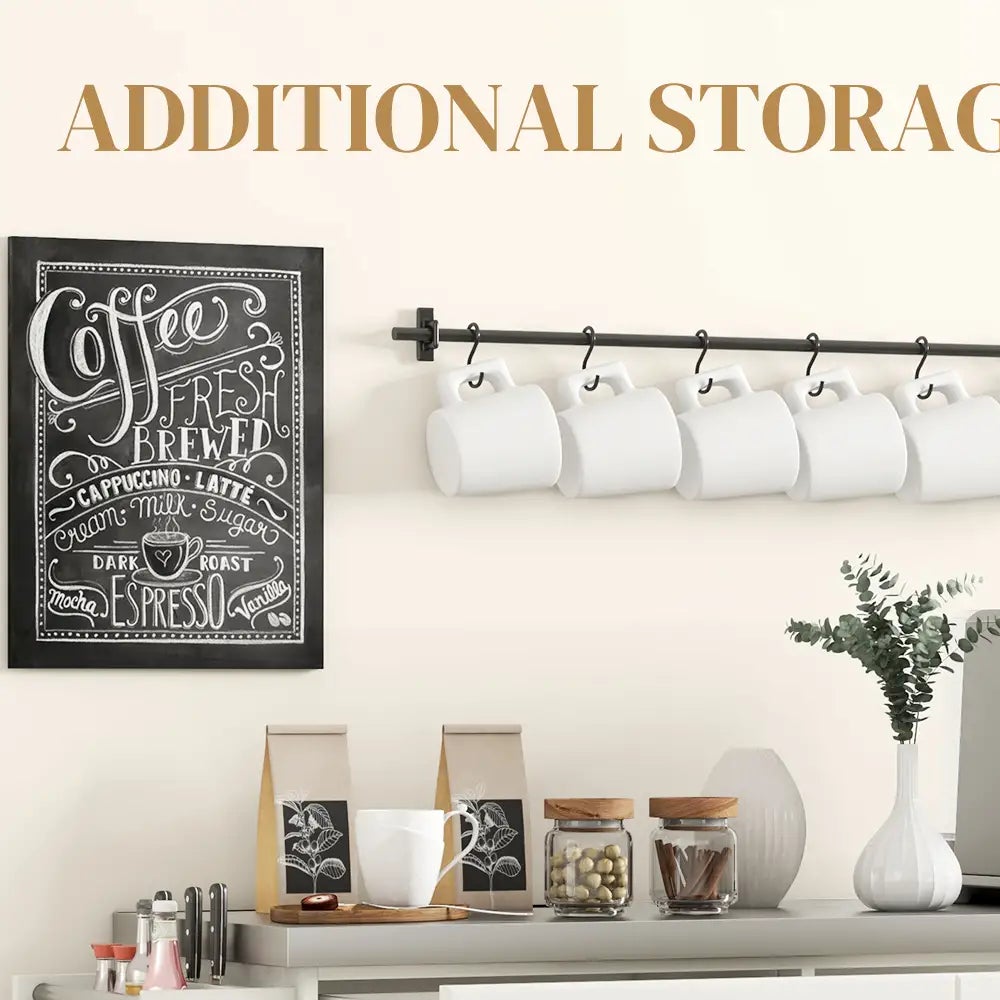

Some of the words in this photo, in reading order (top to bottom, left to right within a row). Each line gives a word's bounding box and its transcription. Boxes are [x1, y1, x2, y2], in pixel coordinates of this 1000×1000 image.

[27, 284, 266, 447] Coffee
[160, 361, 290, 438] FRESH
[131, 417, 271, 465] BREWED
[77, 469, 181, 508] CAPPUCCINO
[54, 507, 126, 551] Cream
[200, 499, 279, 545] Sugar
[93, 555, 139, 571] DARK
[200, 555, 253, 572] ROAST
[111, 573, 225, 630] ESPRESSO
[235, 580, 290, 620] Vanilla
